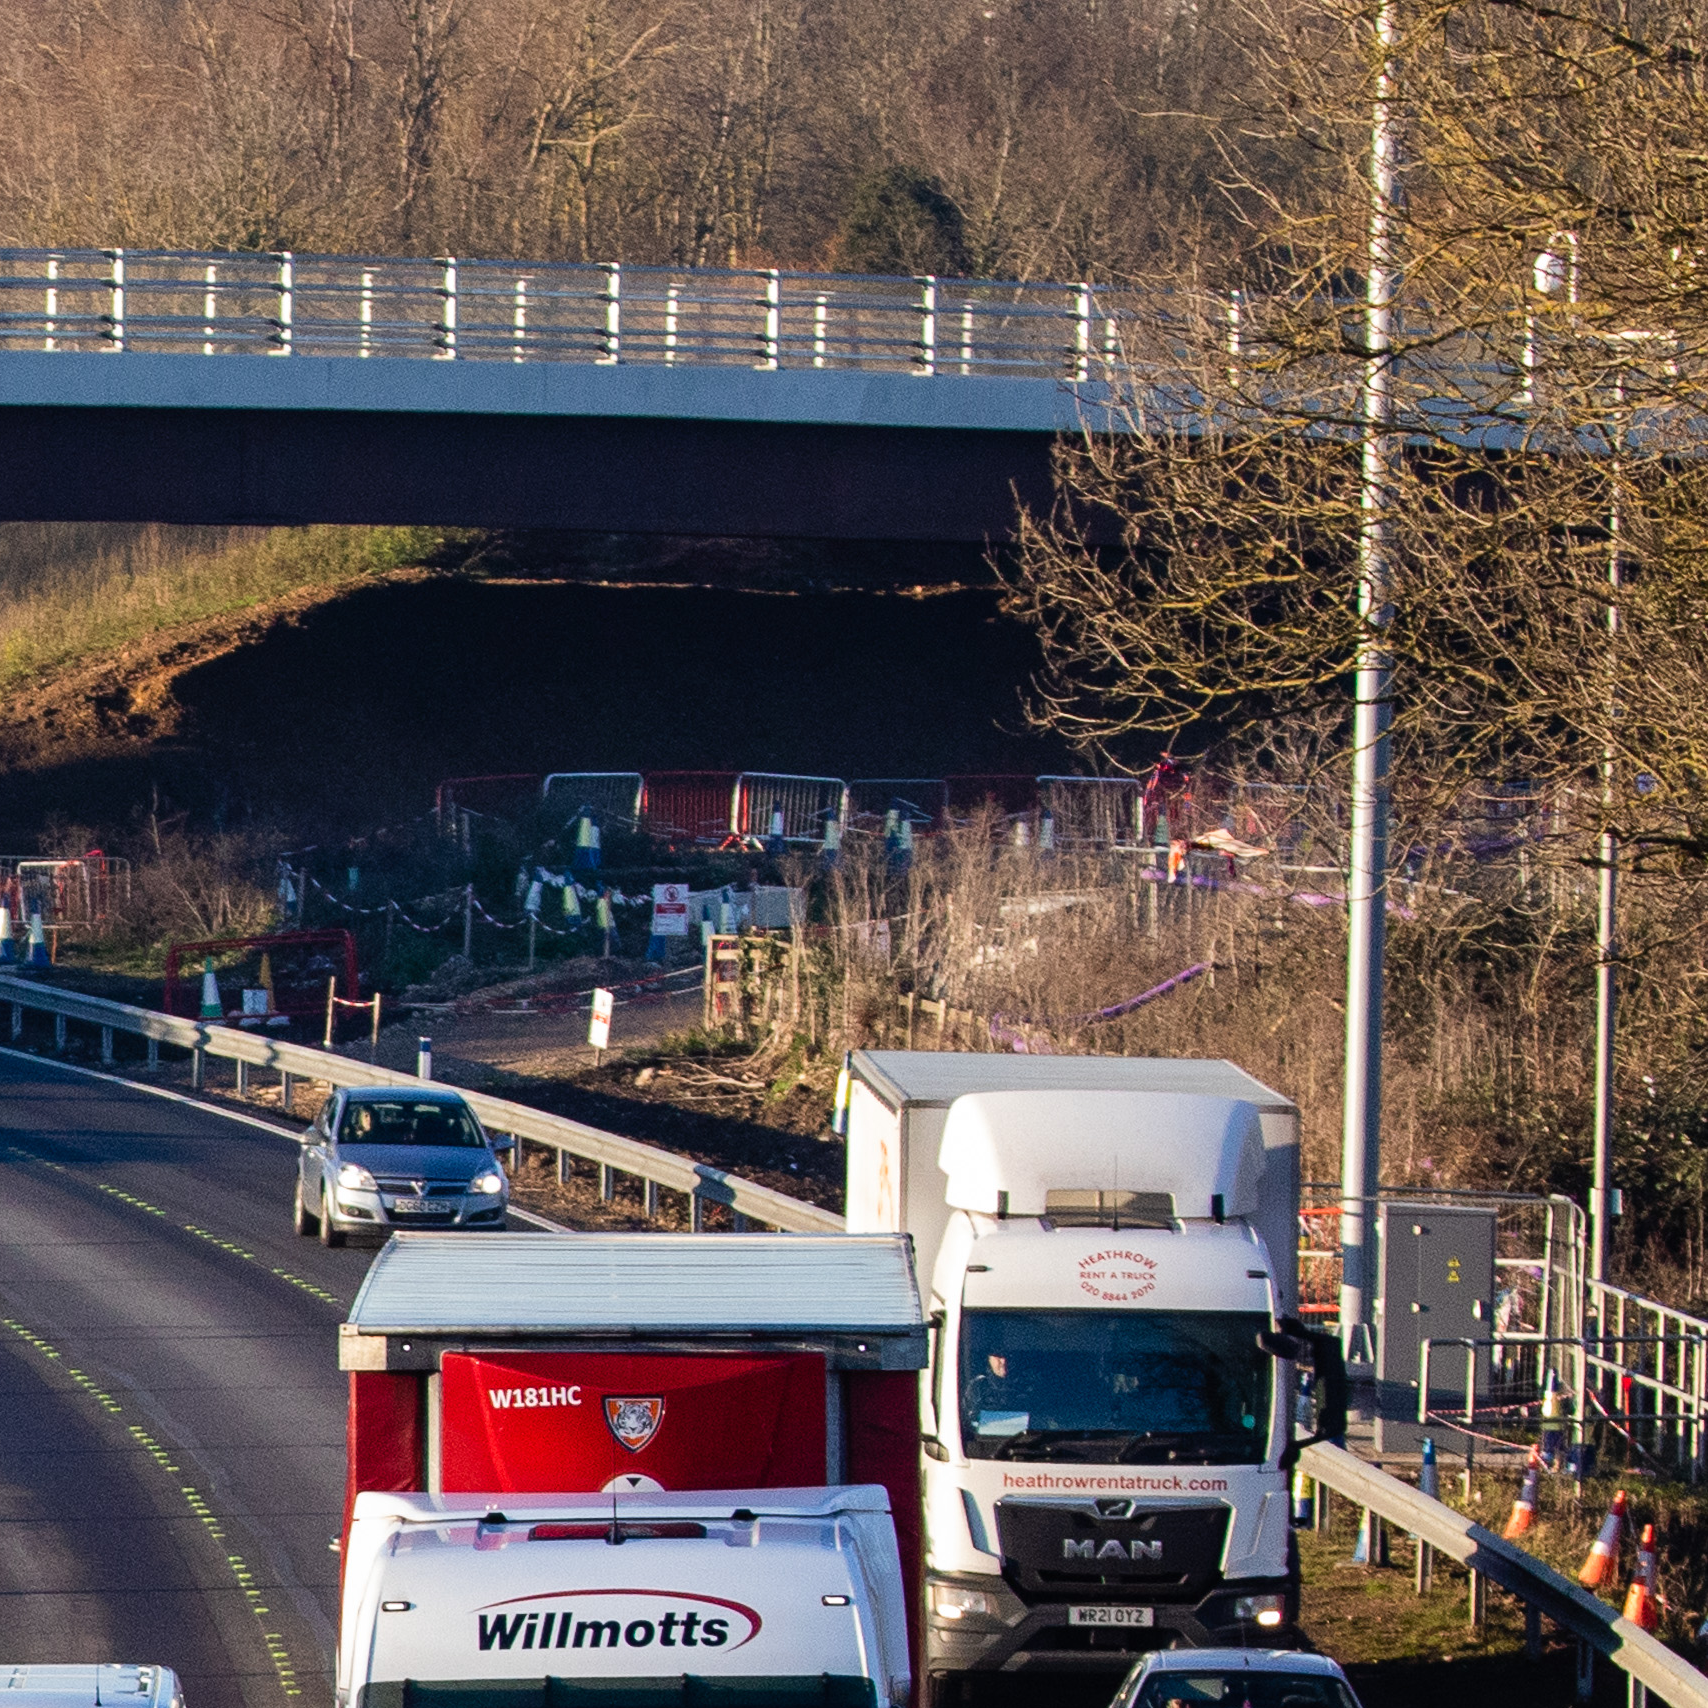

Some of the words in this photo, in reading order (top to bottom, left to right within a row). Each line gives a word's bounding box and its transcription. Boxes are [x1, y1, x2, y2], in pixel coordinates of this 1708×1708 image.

[1078, 1249, 1158, 1270] HEATHROW
[1079, 1271, 1106, 1279] RENT
[1110, 1271, 1118, 1279] A
[1121, 1271, 1157, 1281] TRUCK
[1080, 1280, 1100, 1297] 020
[488, 1385, 582, 1409] W181HC
[1003, 1472, 1228, 1491] heathrowrentatruck.com
[1062, 1537, 1163, 1560] MAN
[477, 1611, 730, 1651] Willmotts
